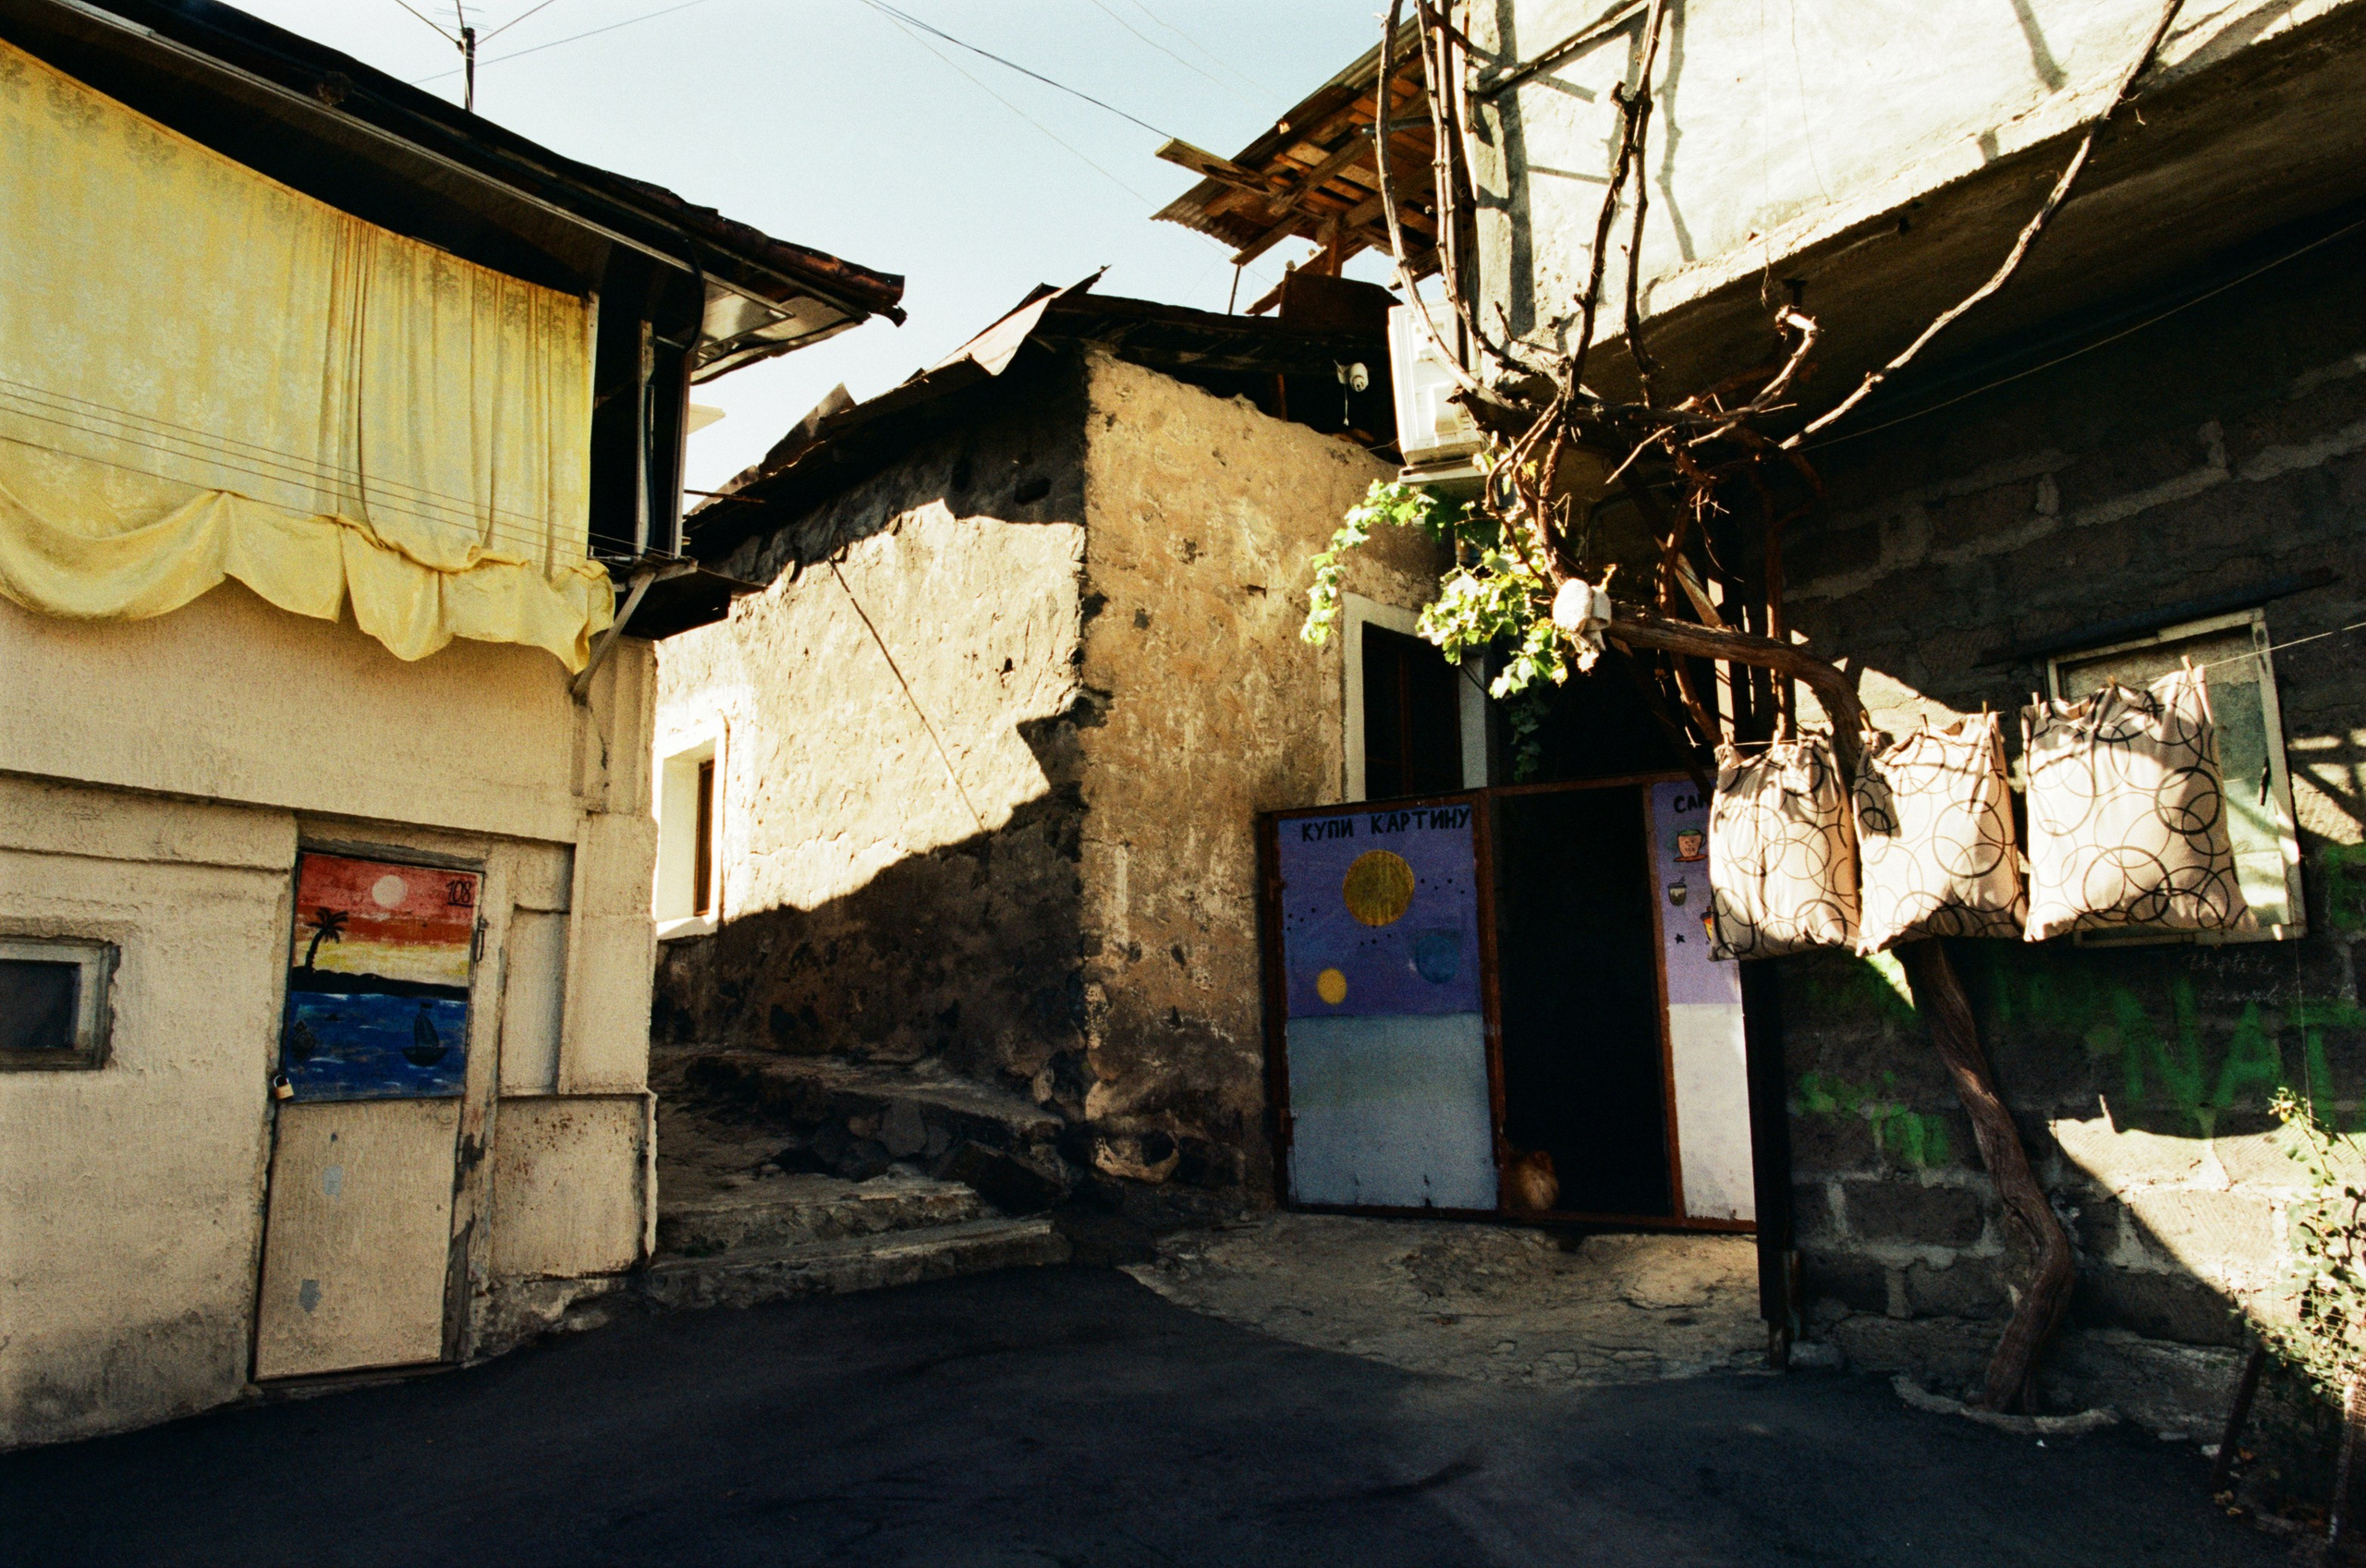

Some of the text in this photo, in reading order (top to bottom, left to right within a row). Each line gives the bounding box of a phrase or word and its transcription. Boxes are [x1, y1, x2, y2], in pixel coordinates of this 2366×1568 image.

[1301, 808, 1470, 842] КУПИ КАРТИНУ
[445, 879, 472, 904] 108
